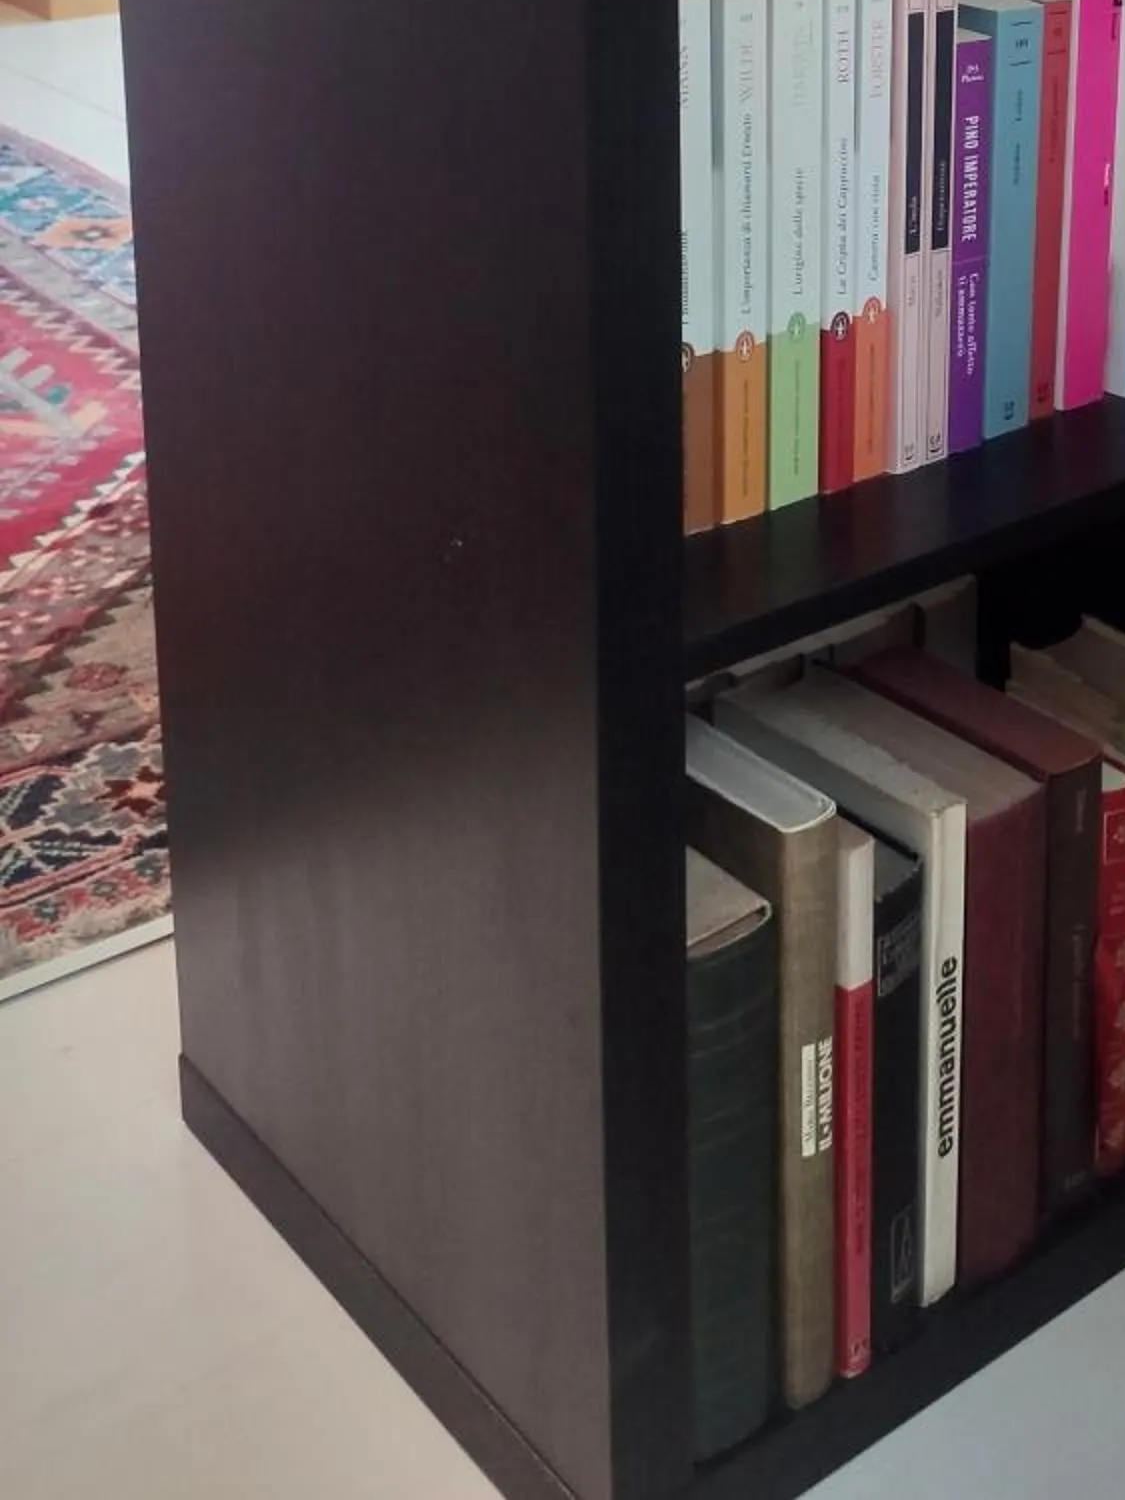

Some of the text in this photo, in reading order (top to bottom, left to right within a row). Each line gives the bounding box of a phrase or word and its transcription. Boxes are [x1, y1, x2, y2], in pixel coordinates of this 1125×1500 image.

[961, 115, 980, 242] PINO IMPERATORE
[935, 956, 957, 1158] emmanuelle
